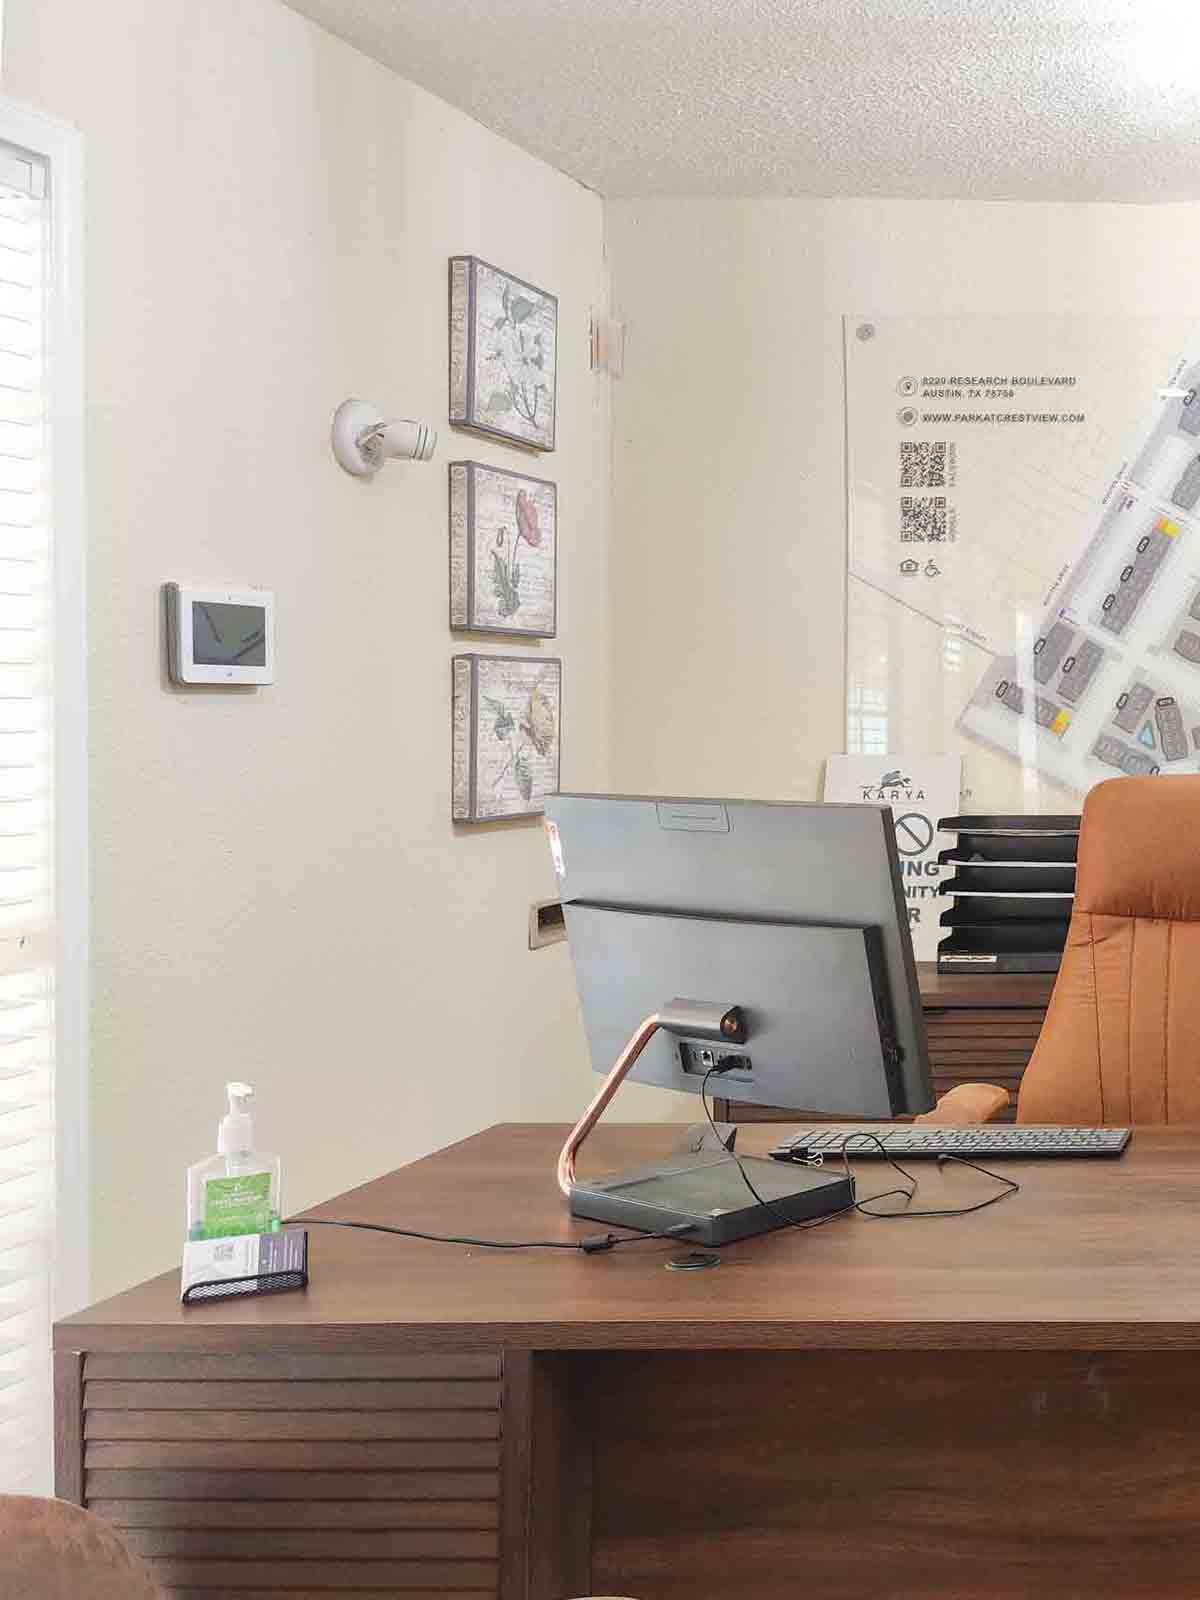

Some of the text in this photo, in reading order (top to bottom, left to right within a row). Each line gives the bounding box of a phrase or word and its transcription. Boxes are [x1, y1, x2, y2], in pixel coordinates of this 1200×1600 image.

[950, 377, 1008, 386] RESEARCH
[1011, 377, 1076, 386] BOULEVARD
[968, 389, 981, 397] TX
[922, 414, 1085, 423] WWW.PARKATCRESTVIEW.COM
[863, 789, 925, 800] KARYA
[899, 861, 939, 876] ING
